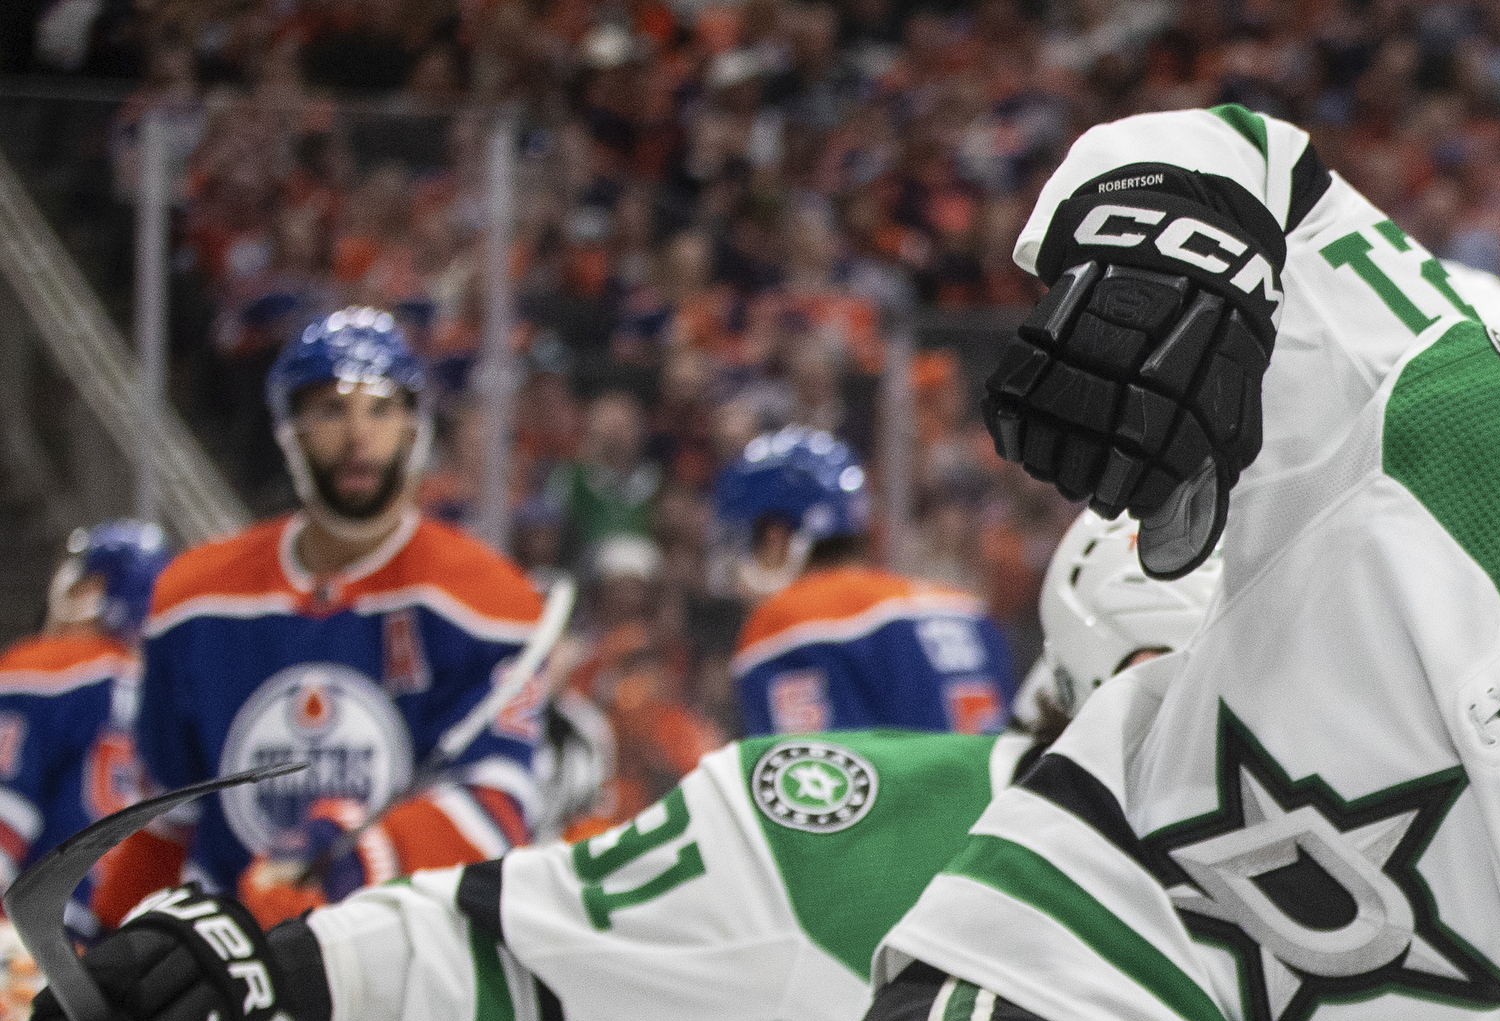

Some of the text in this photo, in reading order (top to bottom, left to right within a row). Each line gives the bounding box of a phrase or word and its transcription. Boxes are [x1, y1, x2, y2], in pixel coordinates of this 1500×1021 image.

[1098, 173, 1164, 194] ROBERTSON
[1073, 204, 1284, 332] CCM
[119, 886, 276, 1016] UER
